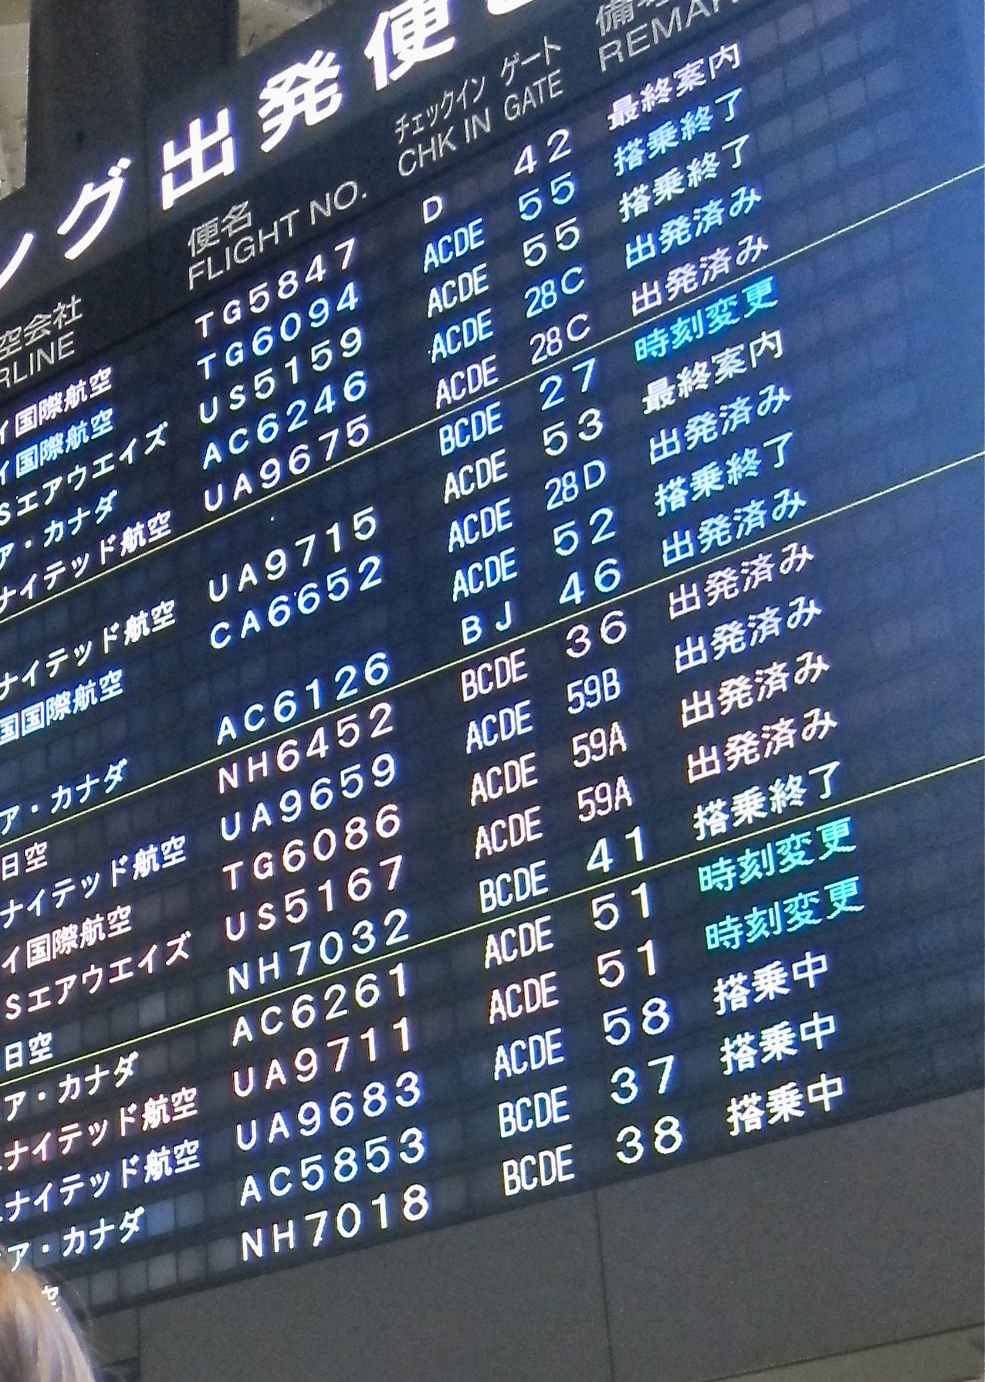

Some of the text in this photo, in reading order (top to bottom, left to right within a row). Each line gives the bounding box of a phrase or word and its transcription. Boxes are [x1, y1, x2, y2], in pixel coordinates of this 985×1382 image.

[398, 68, 563, 176] CHK IN GATE
[607, 42, 741, 131] 最終案内
[513, 128, 572, 175] 42
[618, 133, 750, 223] 搭乗終了
[188, 200, 252, 257] 便名
[188, 180, 367, 290] FLIGHT NO.
[423, 217, 485, 273] ACDE
[625, 185, 762, 270] 出発済み
[194, 237, 356, 338] TG5847
[524, 266, 585, 319] 28C
[634, 275, 779, 361] 時刻変更
[196, 281, 359, 380] TG6094
[431, 307, 494, 363] ACDE
[199, 326, 363, 424] US5159
[539, 357, 596, 411] 27
[204, 413, 369, 512] UA9675
[438, 400, 504, 457] BCDE
[544, 459, 607, 511] 28D
[654, 431, 793, 517] 搭乗終了
[208, 505, 377, 603] UA9715
[448, 496, 513, 553] ACDE
[210, 555, 382, 649] CA6652
[674, 596, 823, 674] 出発済み
[216, 651, 390, 746] AC6126
[461, 647, 529, 702] BCDE
[566, 667, 622, 715] 59B
[218, 701, 393, 794] NH6452
[470, 751, 538, 807] ACDE
[572, 721, 628, 768] 59A
[693, 760, 841, 841] 搭乗終了
[222, 803, 401, 891] TG6086
[586, 826, 644, 873] 41
[228, 908, 409, 995] NH7032
[484, 914, 555, 970] ACDE
[705, 875, 865, 950] 時刻変更
[232, 961, 406, 1047] AC6261
[602, 997, 670, 1046] 58
[236, 1070, 421, 1151] UA9683
[727, 1073, 844, 1136] 搭乗中
[240, 1126, 425, 1207] AC5853
[502, 1143, 576, 1196] BCDE
[242, 1183, 430, 1262] NH7018
